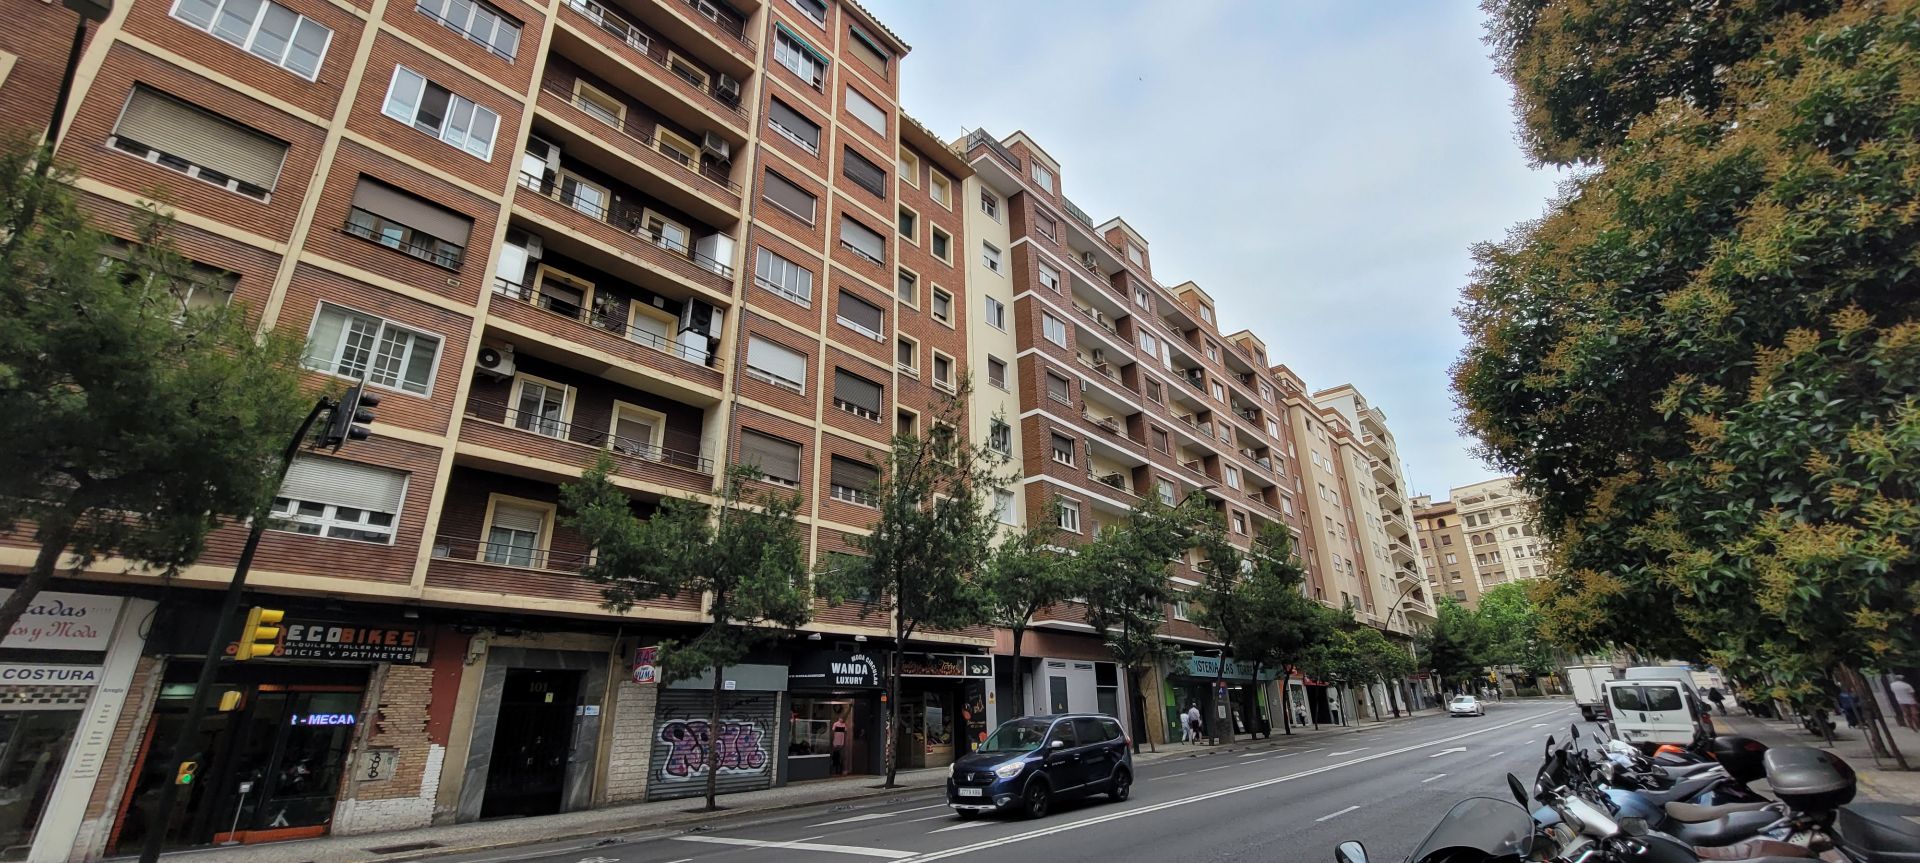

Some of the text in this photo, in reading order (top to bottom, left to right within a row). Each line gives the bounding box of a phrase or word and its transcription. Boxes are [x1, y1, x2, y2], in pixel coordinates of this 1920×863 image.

[25, 600, 87, 617] adas
[46, 621, 97, 639] Moda
[286, 625, 416, 646] ECOBIKES
[284, 649, 321, 657] BICIS
[341, 651, 412, 660] PATINETES
[2, 668, 95, 681] COSTURA
[831, 662, 868, 675] WANDA
[528, 681, 549, 693] 101
[835, 676, 863, 685] LUXURY
